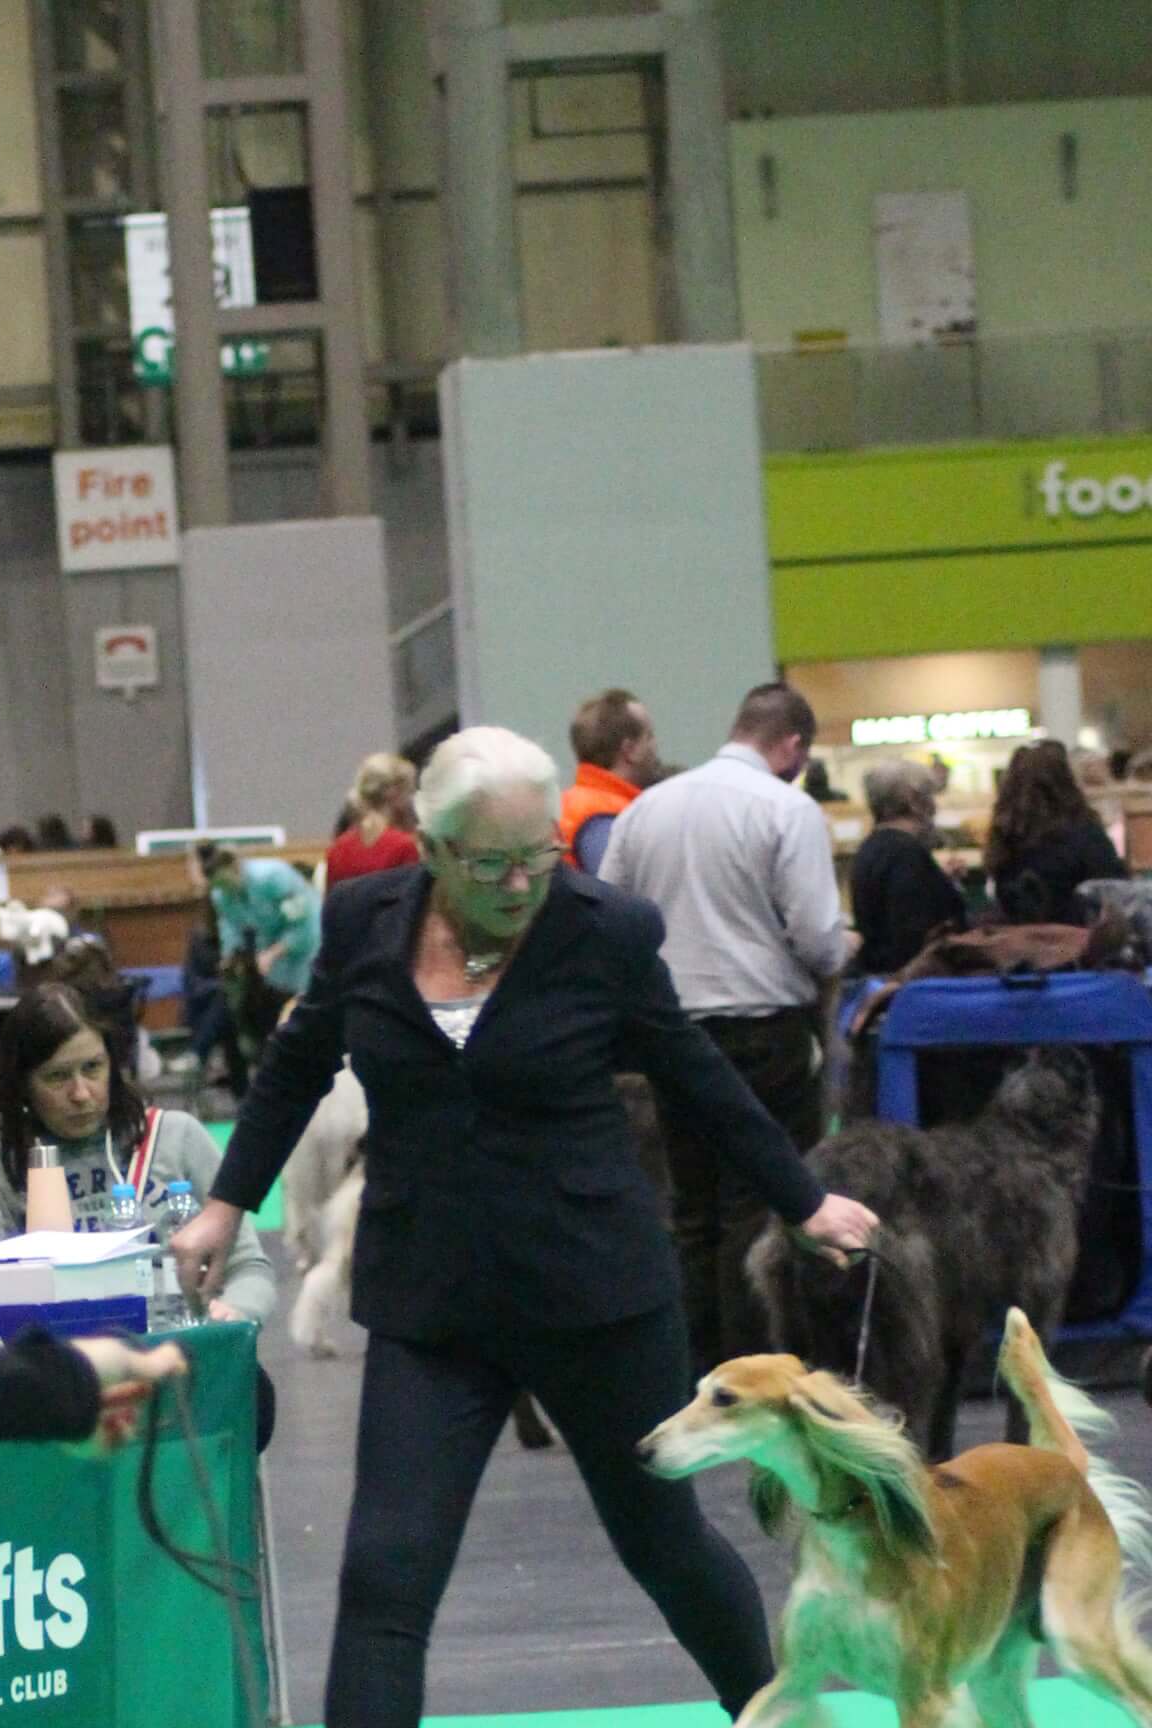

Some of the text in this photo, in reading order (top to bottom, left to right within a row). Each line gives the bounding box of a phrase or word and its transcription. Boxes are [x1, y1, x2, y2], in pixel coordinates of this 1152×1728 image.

[78, 468, 153, 498] Fire
[1040, 459, 1152, 516] foo
[68, 510, 168, 551] point
[10, 1669, 69, 1703] CLUB
